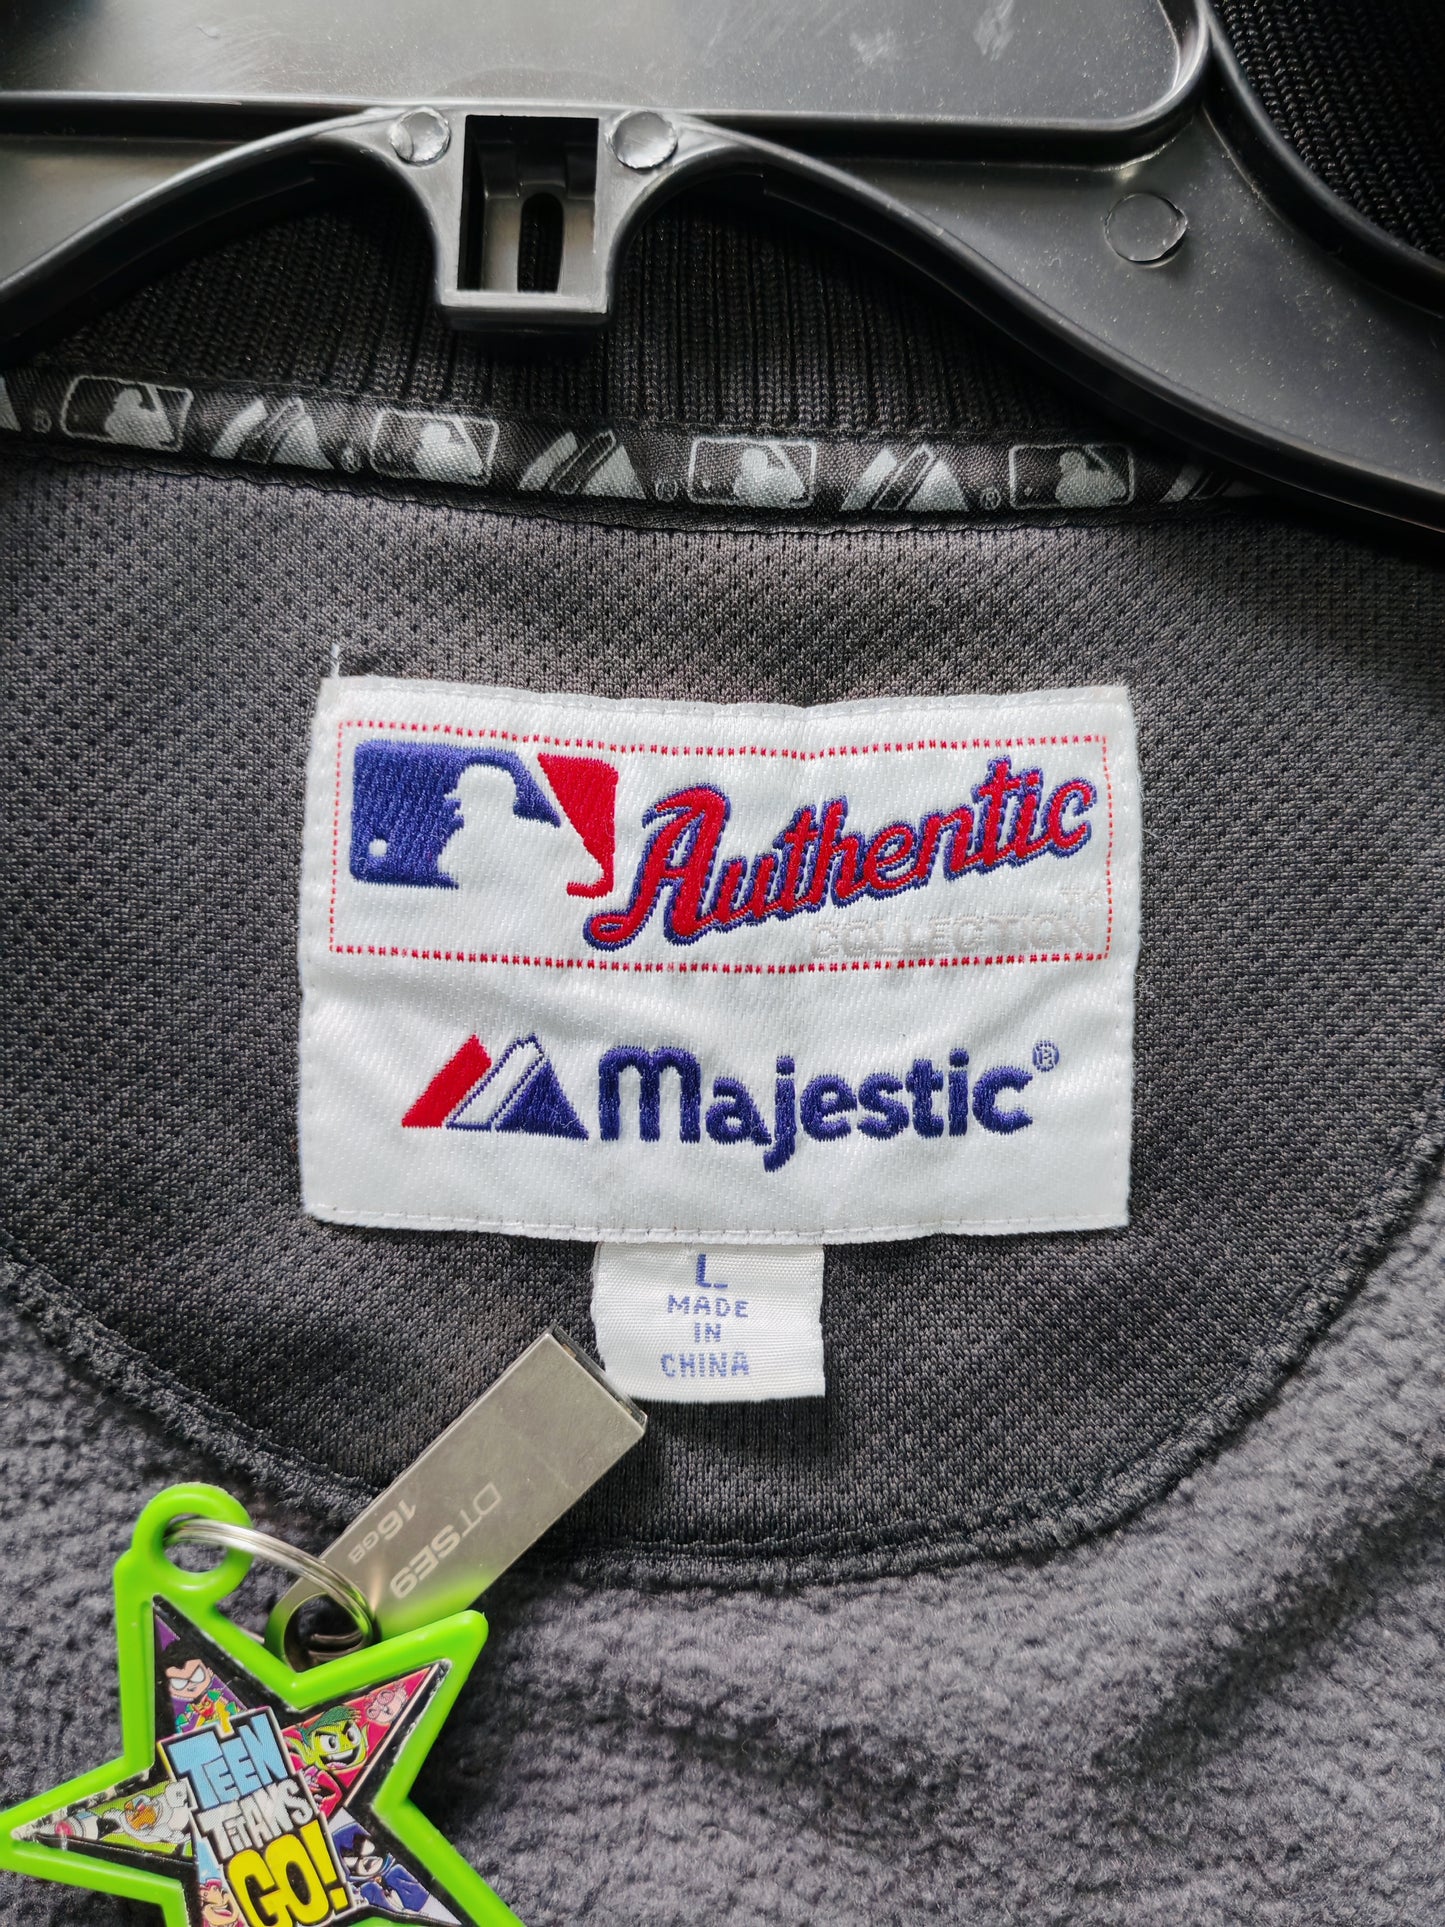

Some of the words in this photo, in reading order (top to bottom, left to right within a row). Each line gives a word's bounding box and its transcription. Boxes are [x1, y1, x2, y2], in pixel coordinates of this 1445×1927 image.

[583, 755, 1098, 951] Authentic
[811, 912, 1101, 958] COLLECTION
[695, 1253, 729, 1290] L
[667, 1294, 750, 1319] MADE
[693, 1321, 723, 1344] IN
[659, 1350, 750, 1379] CHINA
[347, 1499, 417, 1565] 16GB
[389, 1481, 503, 1600] DTSE9
[167, 1712, 289, 1811] TEEN
[227, 1819, 350, 1927] GO!
